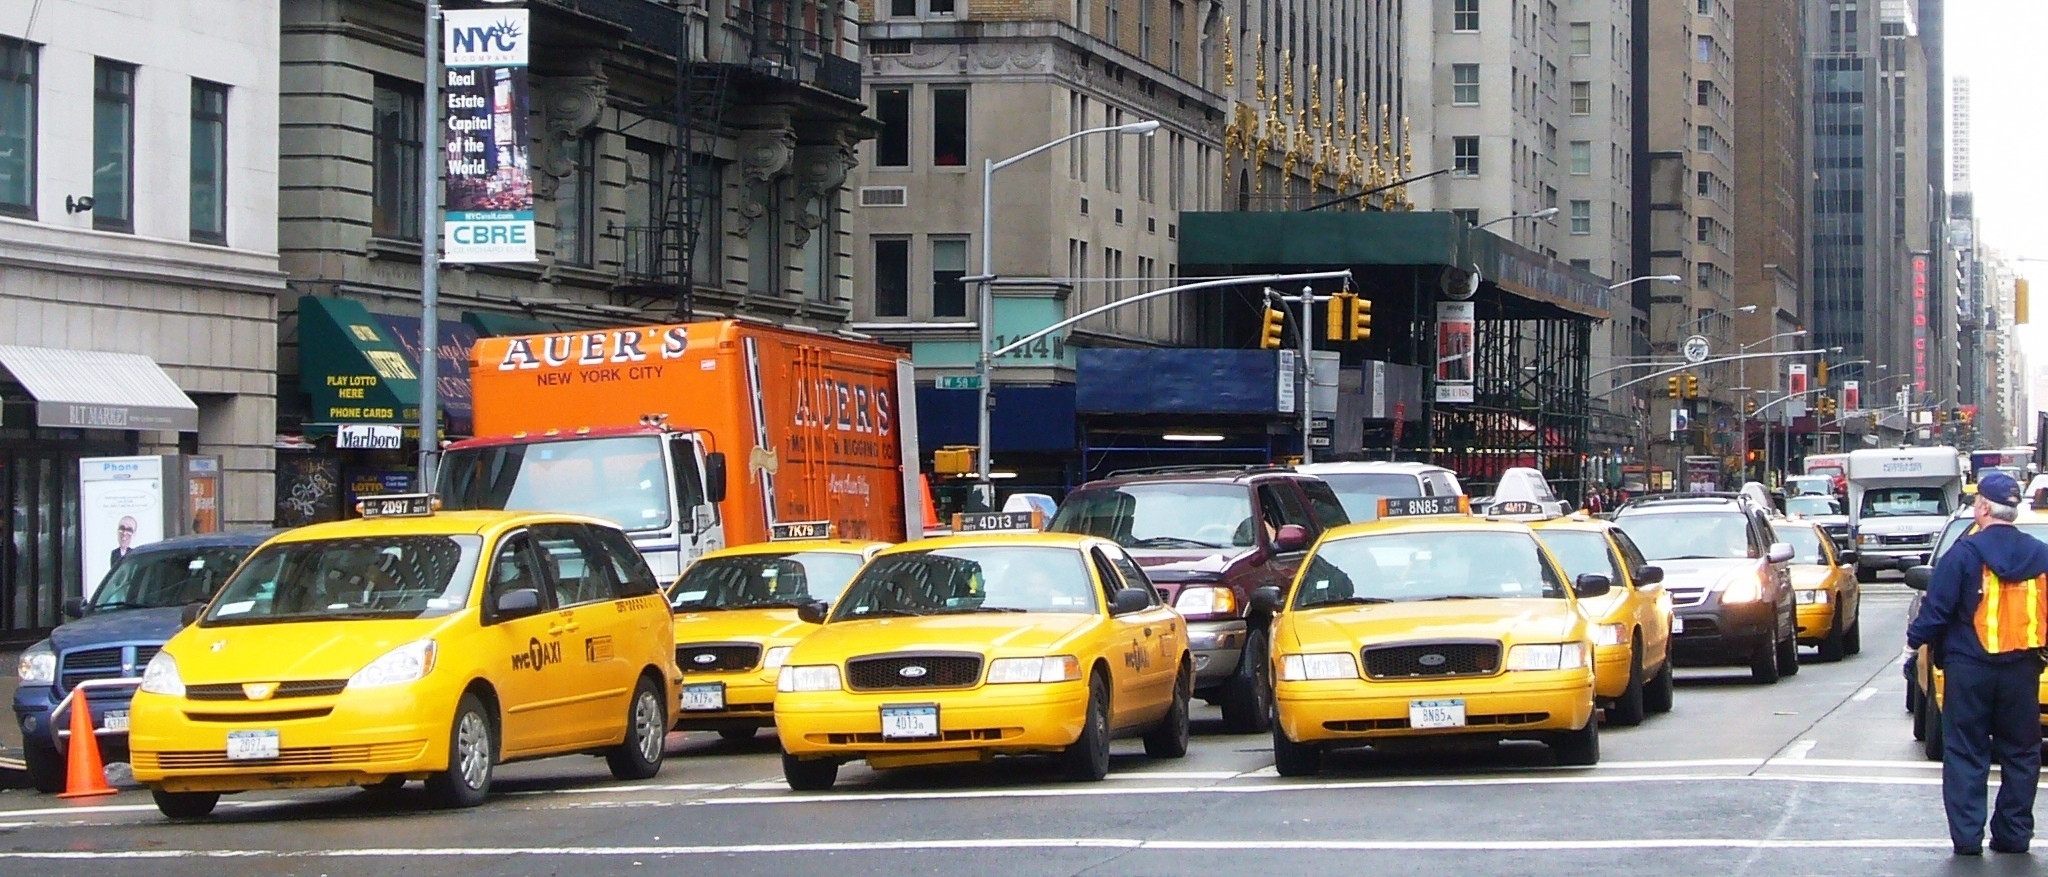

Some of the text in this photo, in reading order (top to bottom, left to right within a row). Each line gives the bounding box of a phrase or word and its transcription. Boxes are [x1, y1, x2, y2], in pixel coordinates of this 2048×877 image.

[453, 22, 518, 53] NYC
[463, 55, 516, 63] COMPANY
[448, 70, 475, 86] Real
[448, 94, 485, 109] Estate
[448, 114, 492, 133] Capital
[448, 137, 485, 153] of the
[448, 159, 486, 175] World
[465, 212, 514, 221] NYCvisit.com
[453, 225, 527, 244] CBRE
[1913, 260, 1926, 392] RADIO CITY
[497, 327, 689, 371] AUER'S
[995, 334, 1049, 358] 1414
[327, 376, 377, 386] PLAY LOTTO
[537, 366, 663, 387] NEW YORK CITY
[338, 388, 364, 398] HERE
[330, 407, 361, 418] PHONE
[363, 408, 394, 418] CARDS
[795, 377, 890, 436] AUER'S
[69, 406, 86, 425] BLT
[88, 407, 129, 426] MARKET
[342, 427, 399, 448] Marlboro
[103, 462, 139, 472] Phone
[351, 483, 383, 492] LOTTO
[381, 500, 409, 514] 2D97
[1409, 499, 1439, 515] 8N85
[1443, 505, 1456, 513] DUTY
[1444, 497, 1454, 505] OFF
[980, 515, 1012, 529] 4D13
[788, 525, 814, 536] 7K79
[511, 655, 530, 671] NYC
